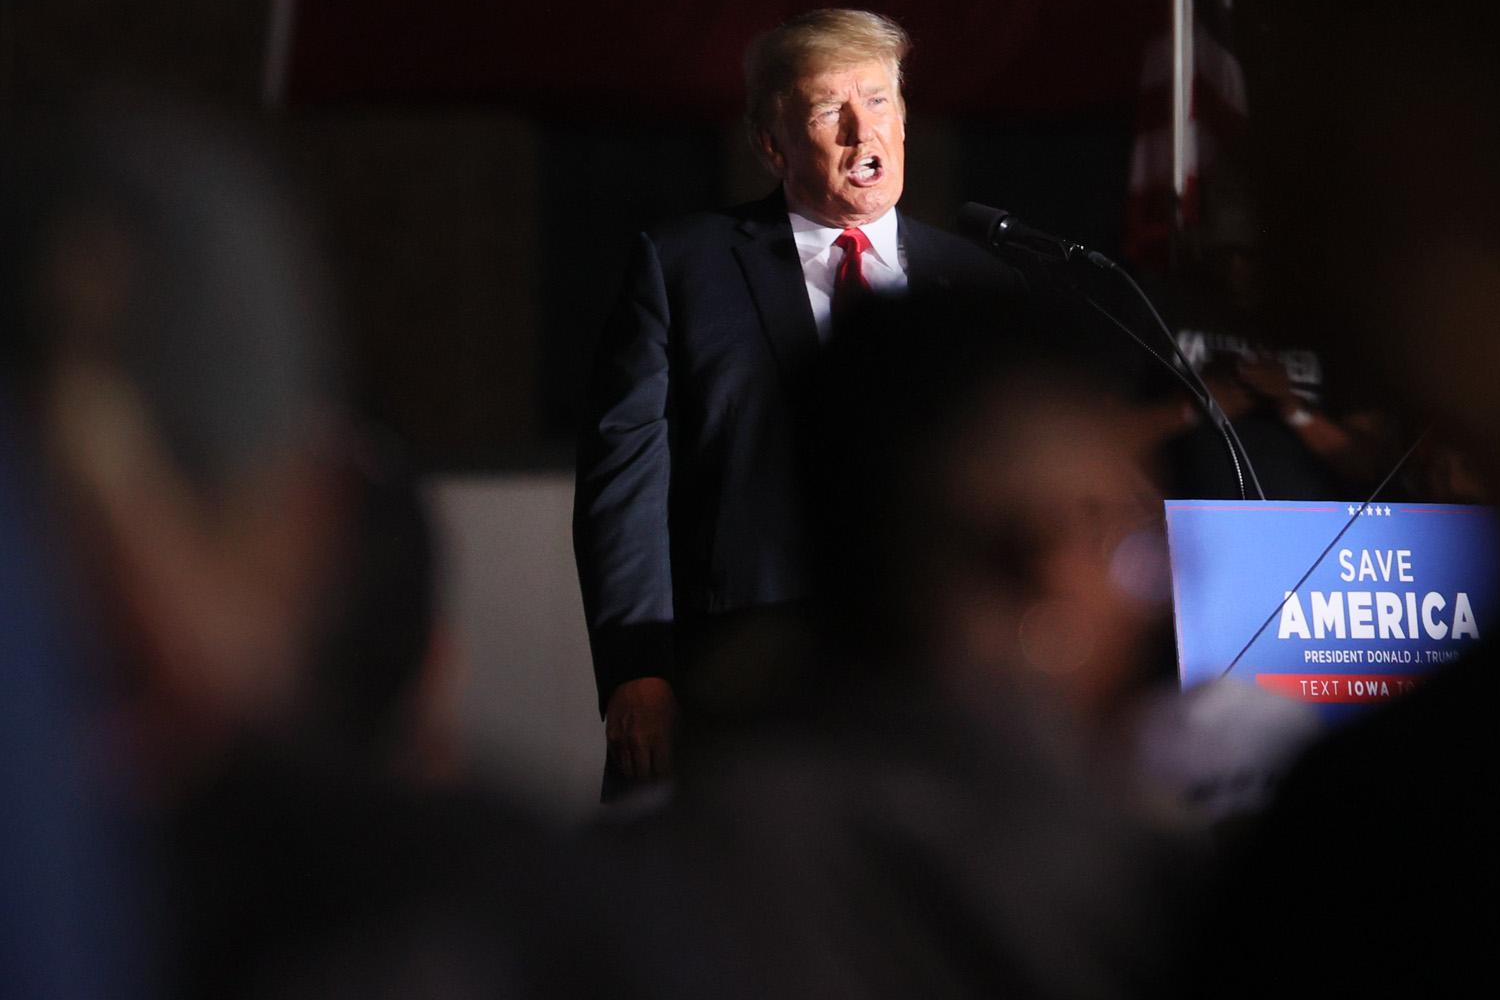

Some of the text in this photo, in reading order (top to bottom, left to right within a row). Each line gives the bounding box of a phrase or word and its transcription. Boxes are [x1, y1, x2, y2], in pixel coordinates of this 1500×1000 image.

[1340, 549, 1414, 582] SAVE
[1279, 592, 1480, 640] AMERICA
[1304, 650, 1363, 664] PRESIDENT
[1367, 650, 1411, 664] DONALD
[1414, 650, 1423, 664] J.
[1300, 680, 1340, 697] TEXT
[1347, 680, 1389, 697] IOWA
